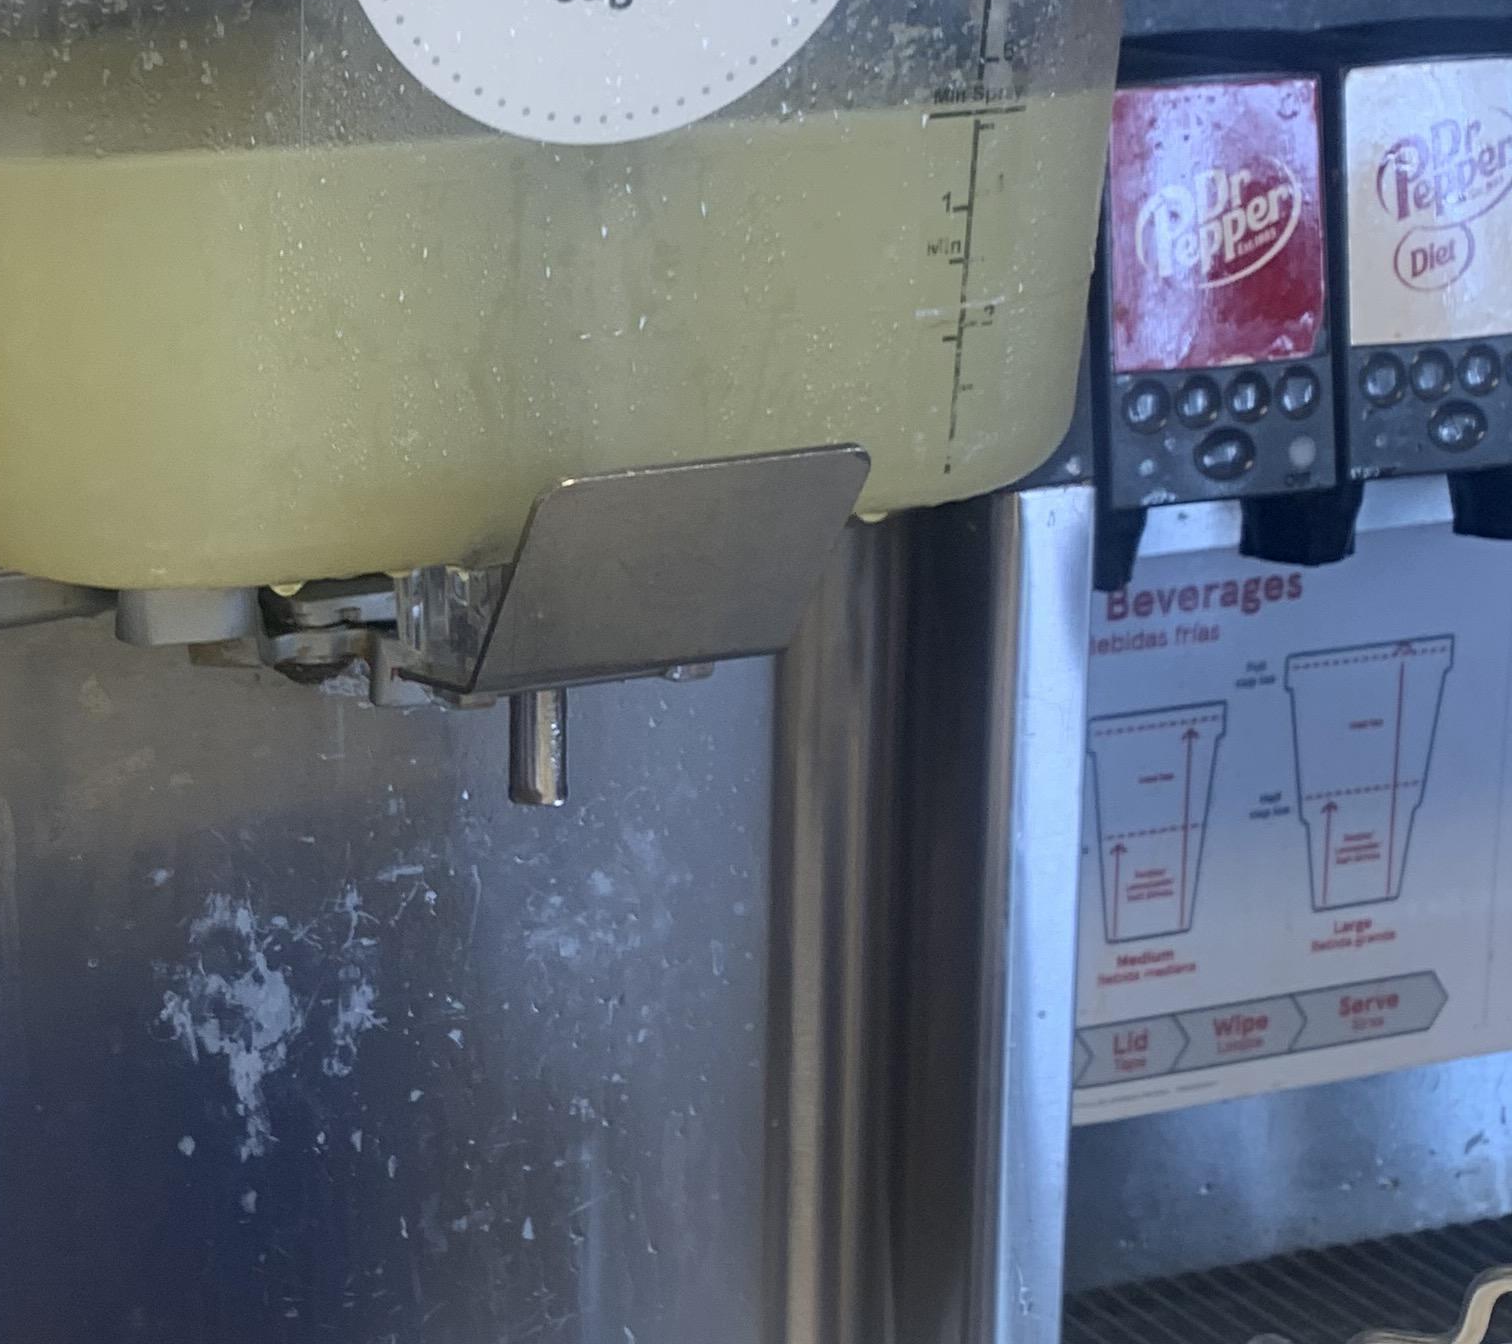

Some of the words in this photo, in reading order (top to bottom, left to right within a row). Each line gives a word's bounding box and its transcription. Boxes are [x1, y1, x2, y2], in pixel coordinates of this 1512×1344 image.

[1154, 184, 1290, 278] Pepper
[1106, 572, 1303, 621] Beverages
[1338, 992, 1399, 1018] Serve
[1213, 1011, 1269, 1038] Wipe
[1112, 1029, 1149, 1056] Lid
